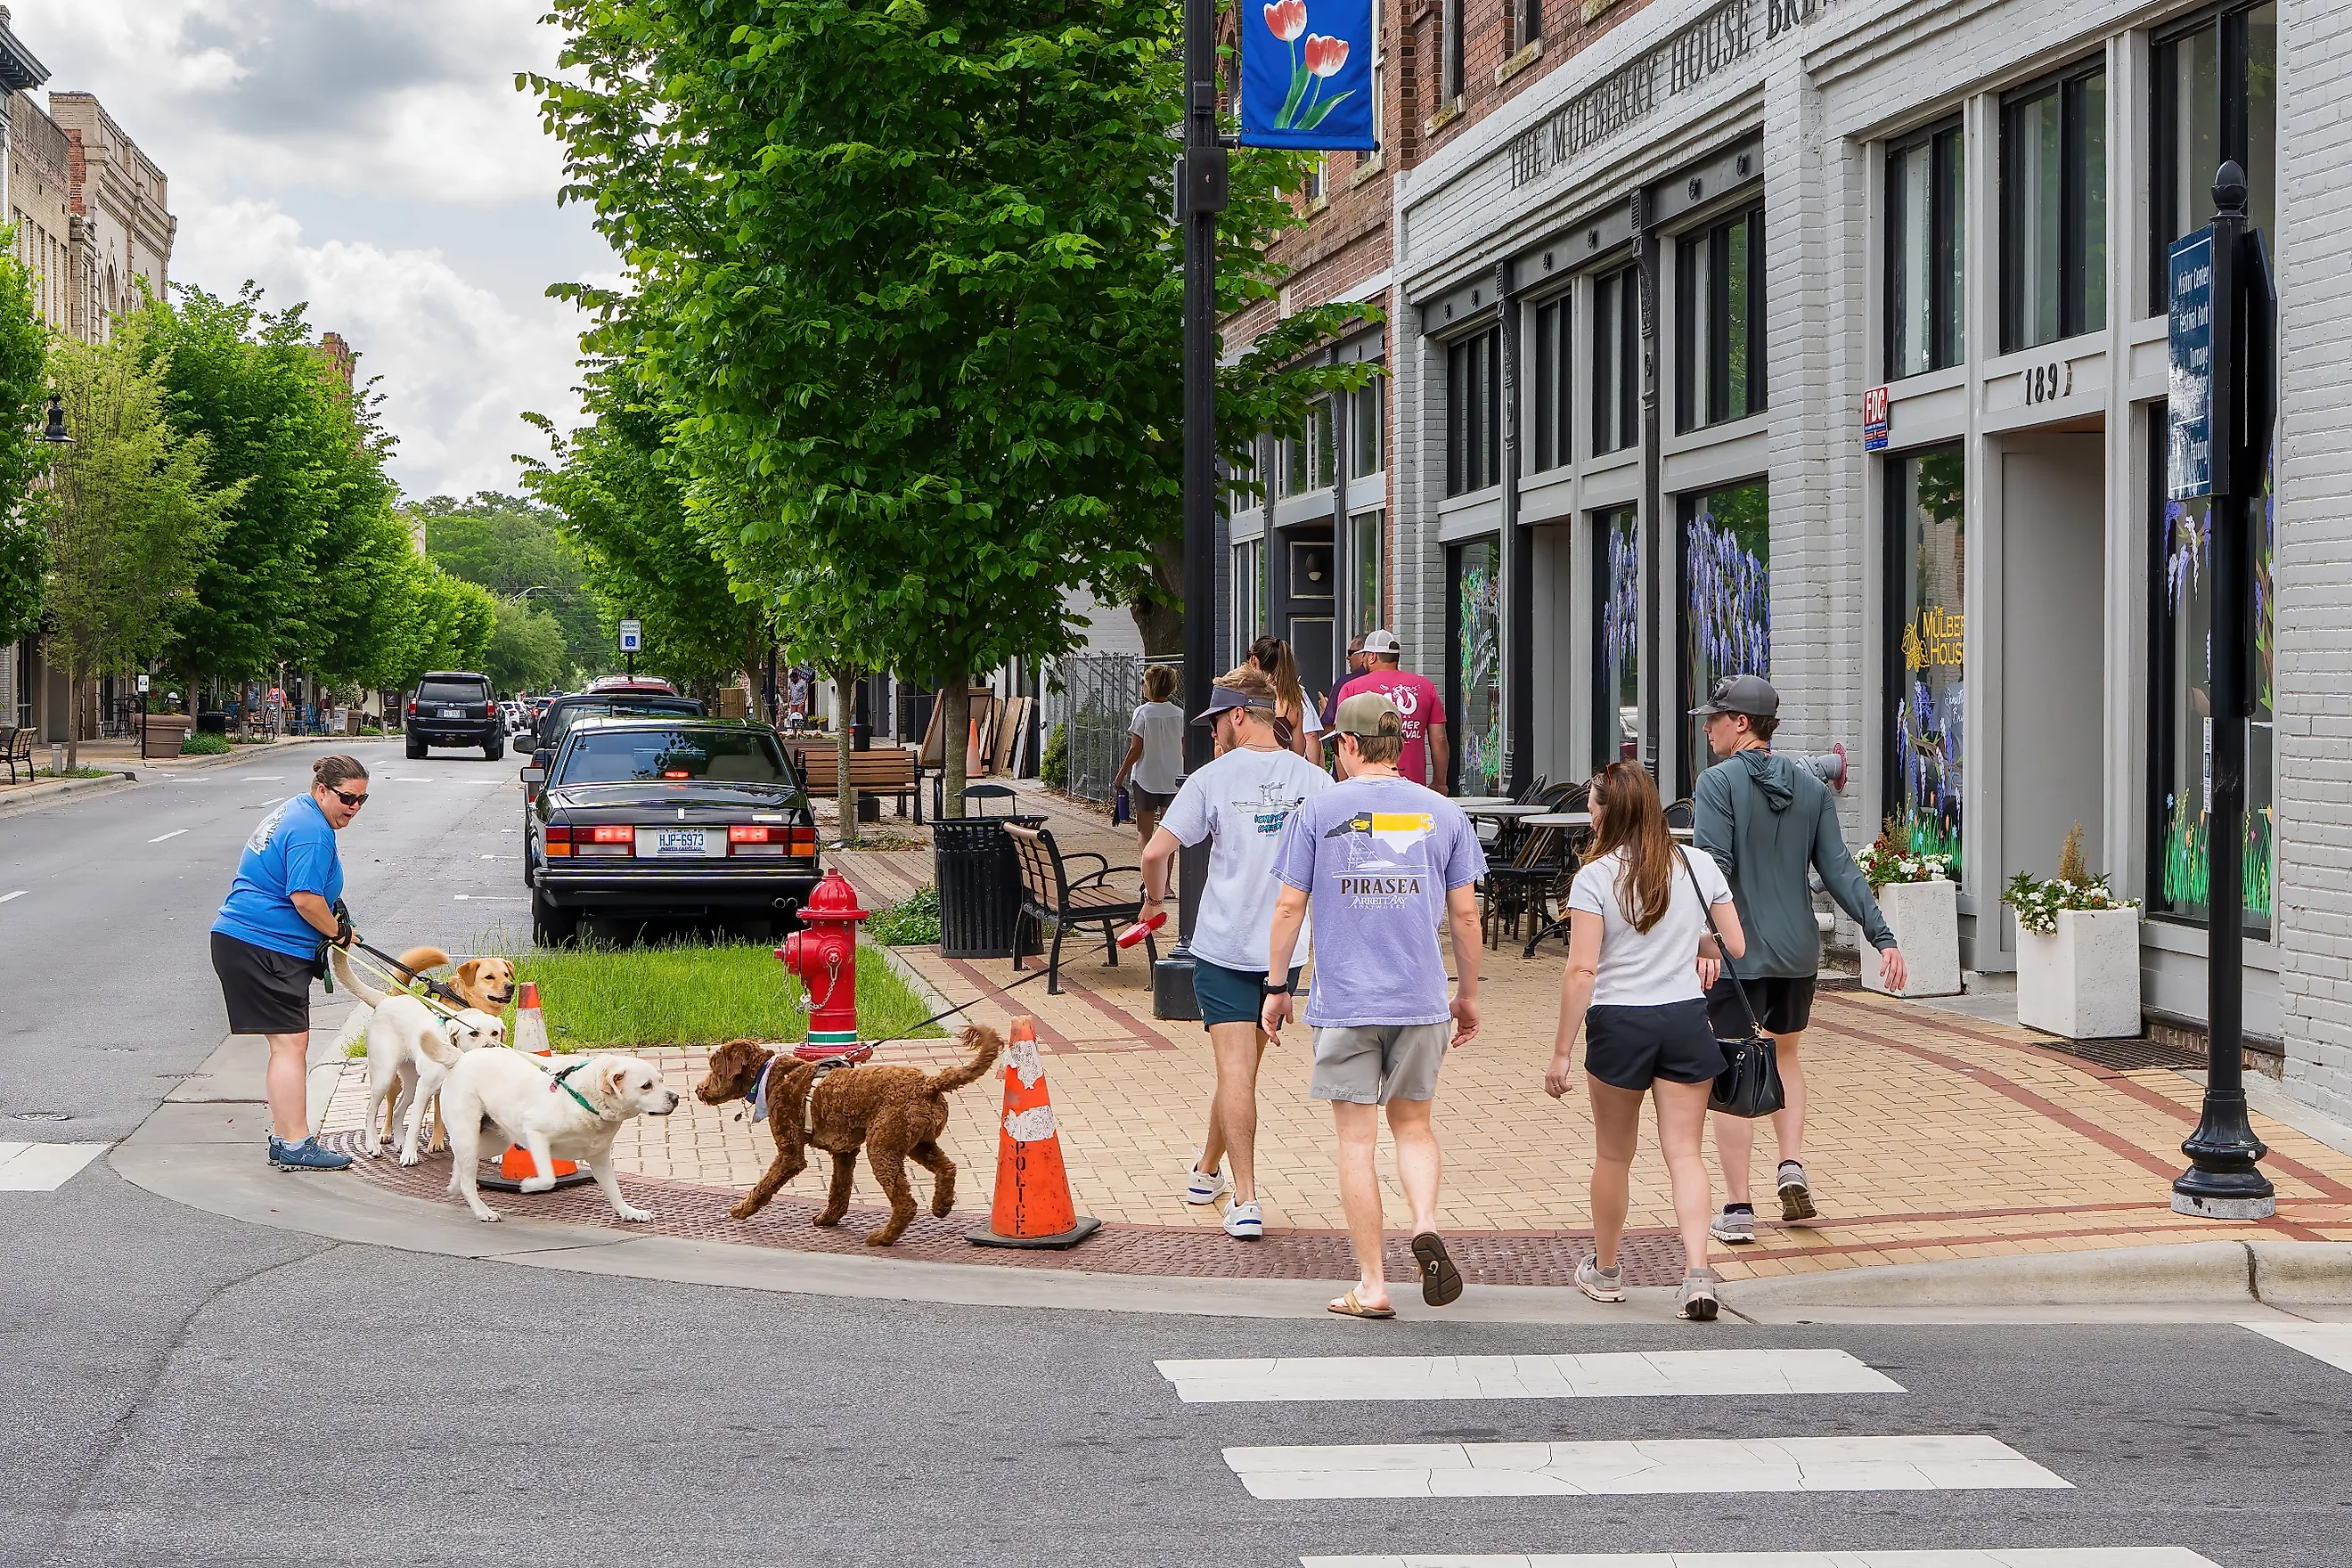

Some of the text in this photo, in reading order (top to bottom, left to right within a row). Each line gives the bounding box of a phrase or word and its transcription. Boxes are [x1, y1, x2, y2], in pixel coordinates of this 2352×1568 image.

[1507, 128, 1546, 191] THE
[1550, 52, 1660, 167] MULBERRY
[1669, 0, 1751, 96] HOUSE
[2177, 265, 2209, 296] Visitor Center
[2179, 302, 2209, 334] Festival Park
[1866, 388, 1885, 424] FDC
[1934, 606, 1944, 617] THE
[659, 833, 704, 846] HJP-6973
[1341, 878, 1420, 894] PIRASEA
[1387, 894, 1408, 905] BAY
[1016, 1141, 1026, 1235] POLICE
